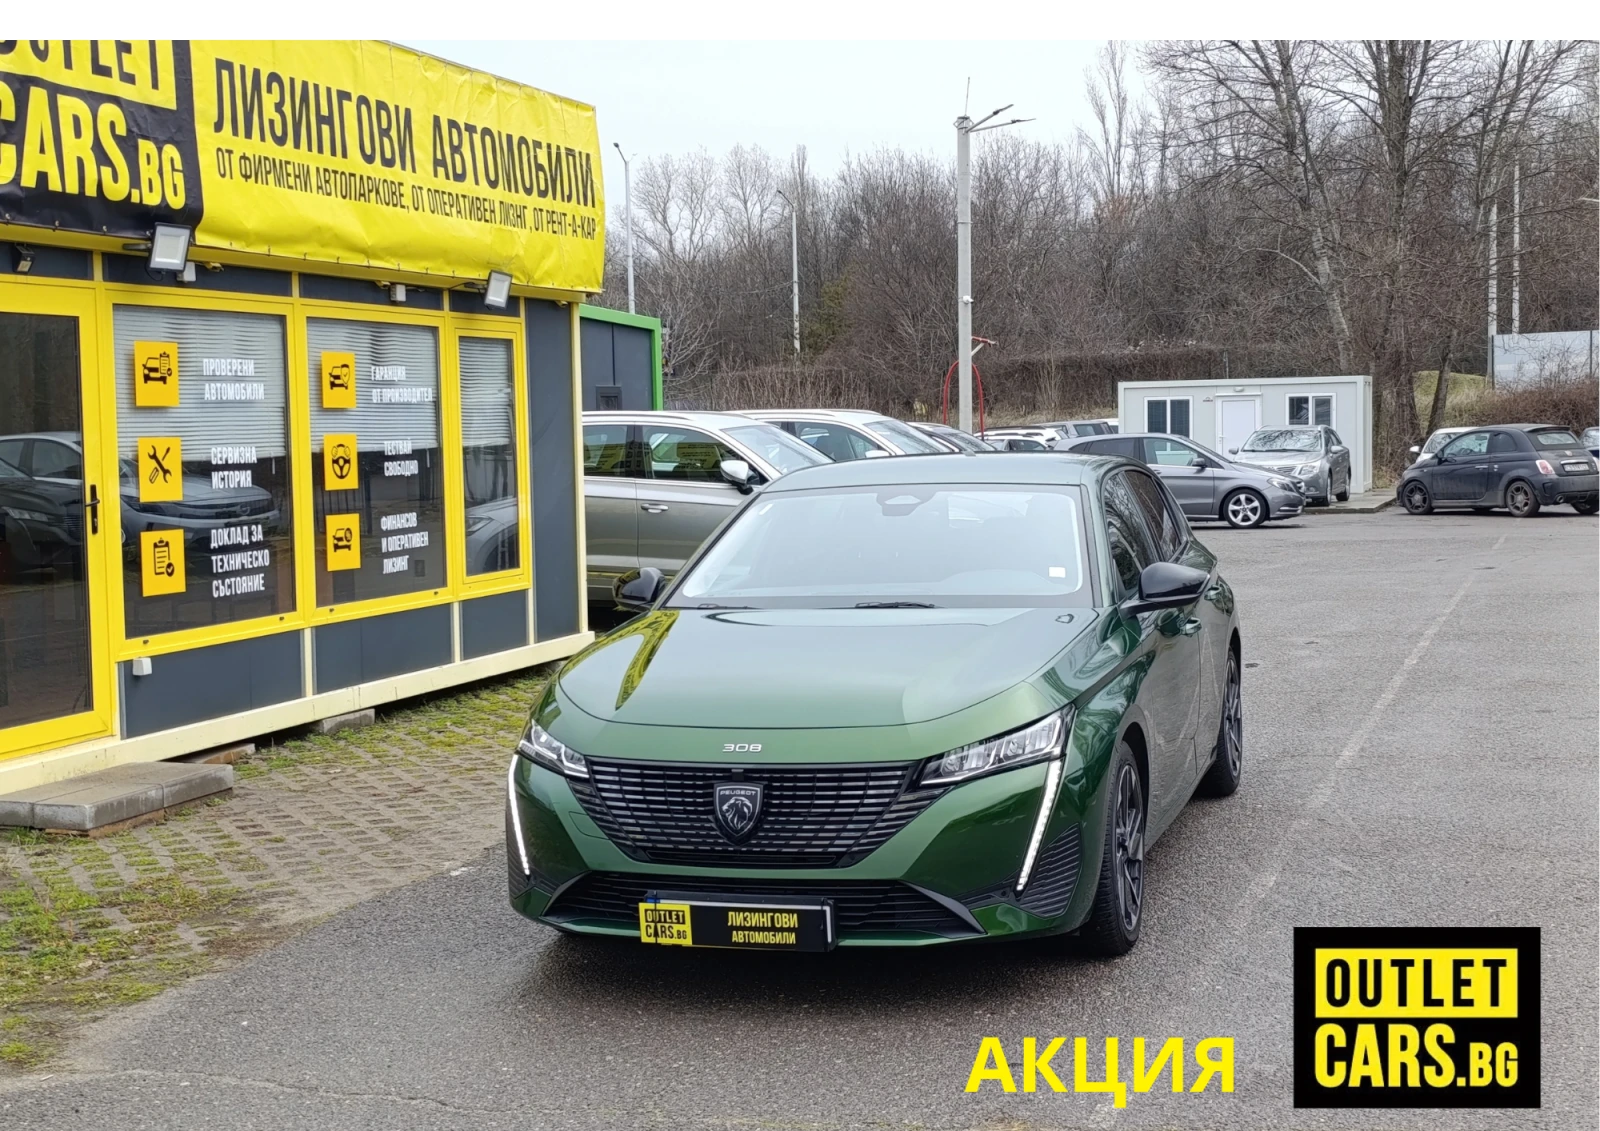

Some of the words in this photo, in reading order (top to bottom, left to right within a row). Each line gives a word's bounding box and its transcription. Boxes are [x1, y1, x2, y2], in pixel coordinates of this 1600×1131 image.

[214, 57, 417, 174] ЛИЗИНГОВИ
[432, 114, 596, 208] АВТОМОБИЛИ
[216, 147, 234, 179] ОТ
[239, 152, 313, 194] ФИРМЕНИ
[316, 167, 410, 214] АВТОПАРКОВЕ,
[412, 184, 426, 213] ОТ
[427, 188, 497, 225] ОПЕРАТИВЕН
[546, 209, 597, 241] РЕНТ-А-КАР
[202, 358, 255, 377] ПРОВЕРЕНИ
[371, 365, 407, 383] ГАРАНЦИЯ
[204, 383, 265, 401] АВТОМОБИЛИ
[372, 389, 383, 404] ОТ
[211, 446, 258, 465] СЕРВИЗНА
[384, 437, 413, 456] ТЕСТВАЙ
[384, 460, 419, 477] СВОБОДНО
[211, 470, 253, 489] ИСТОРИЯ
[381, 512, 418, 531] ФИНАНСОВ
[210, 528, 249, 550] ДОКЛАД
[251, 525, 264, 543] ЗА
[381, 537, 388, 553] И
[388, 531, 429, 552] ОПЕРАТИВЕН
[211, 549, 270, 574] ТЕХНИЧЕСКО
[383, 555, 410, 575] ЛИЗИНГ
[212, 573, 266, 599] СЪСТОЯНИЕ
[722, 743, 762, 752] 308
[646, 910, 684, 923] OUTLET
[727, 911, 798, 928] ЛИЗИНГОВИ
[645, 924, 688, 940] CARS.BG
[731, 930, 796, 945] АВТОМОБИЛИ
